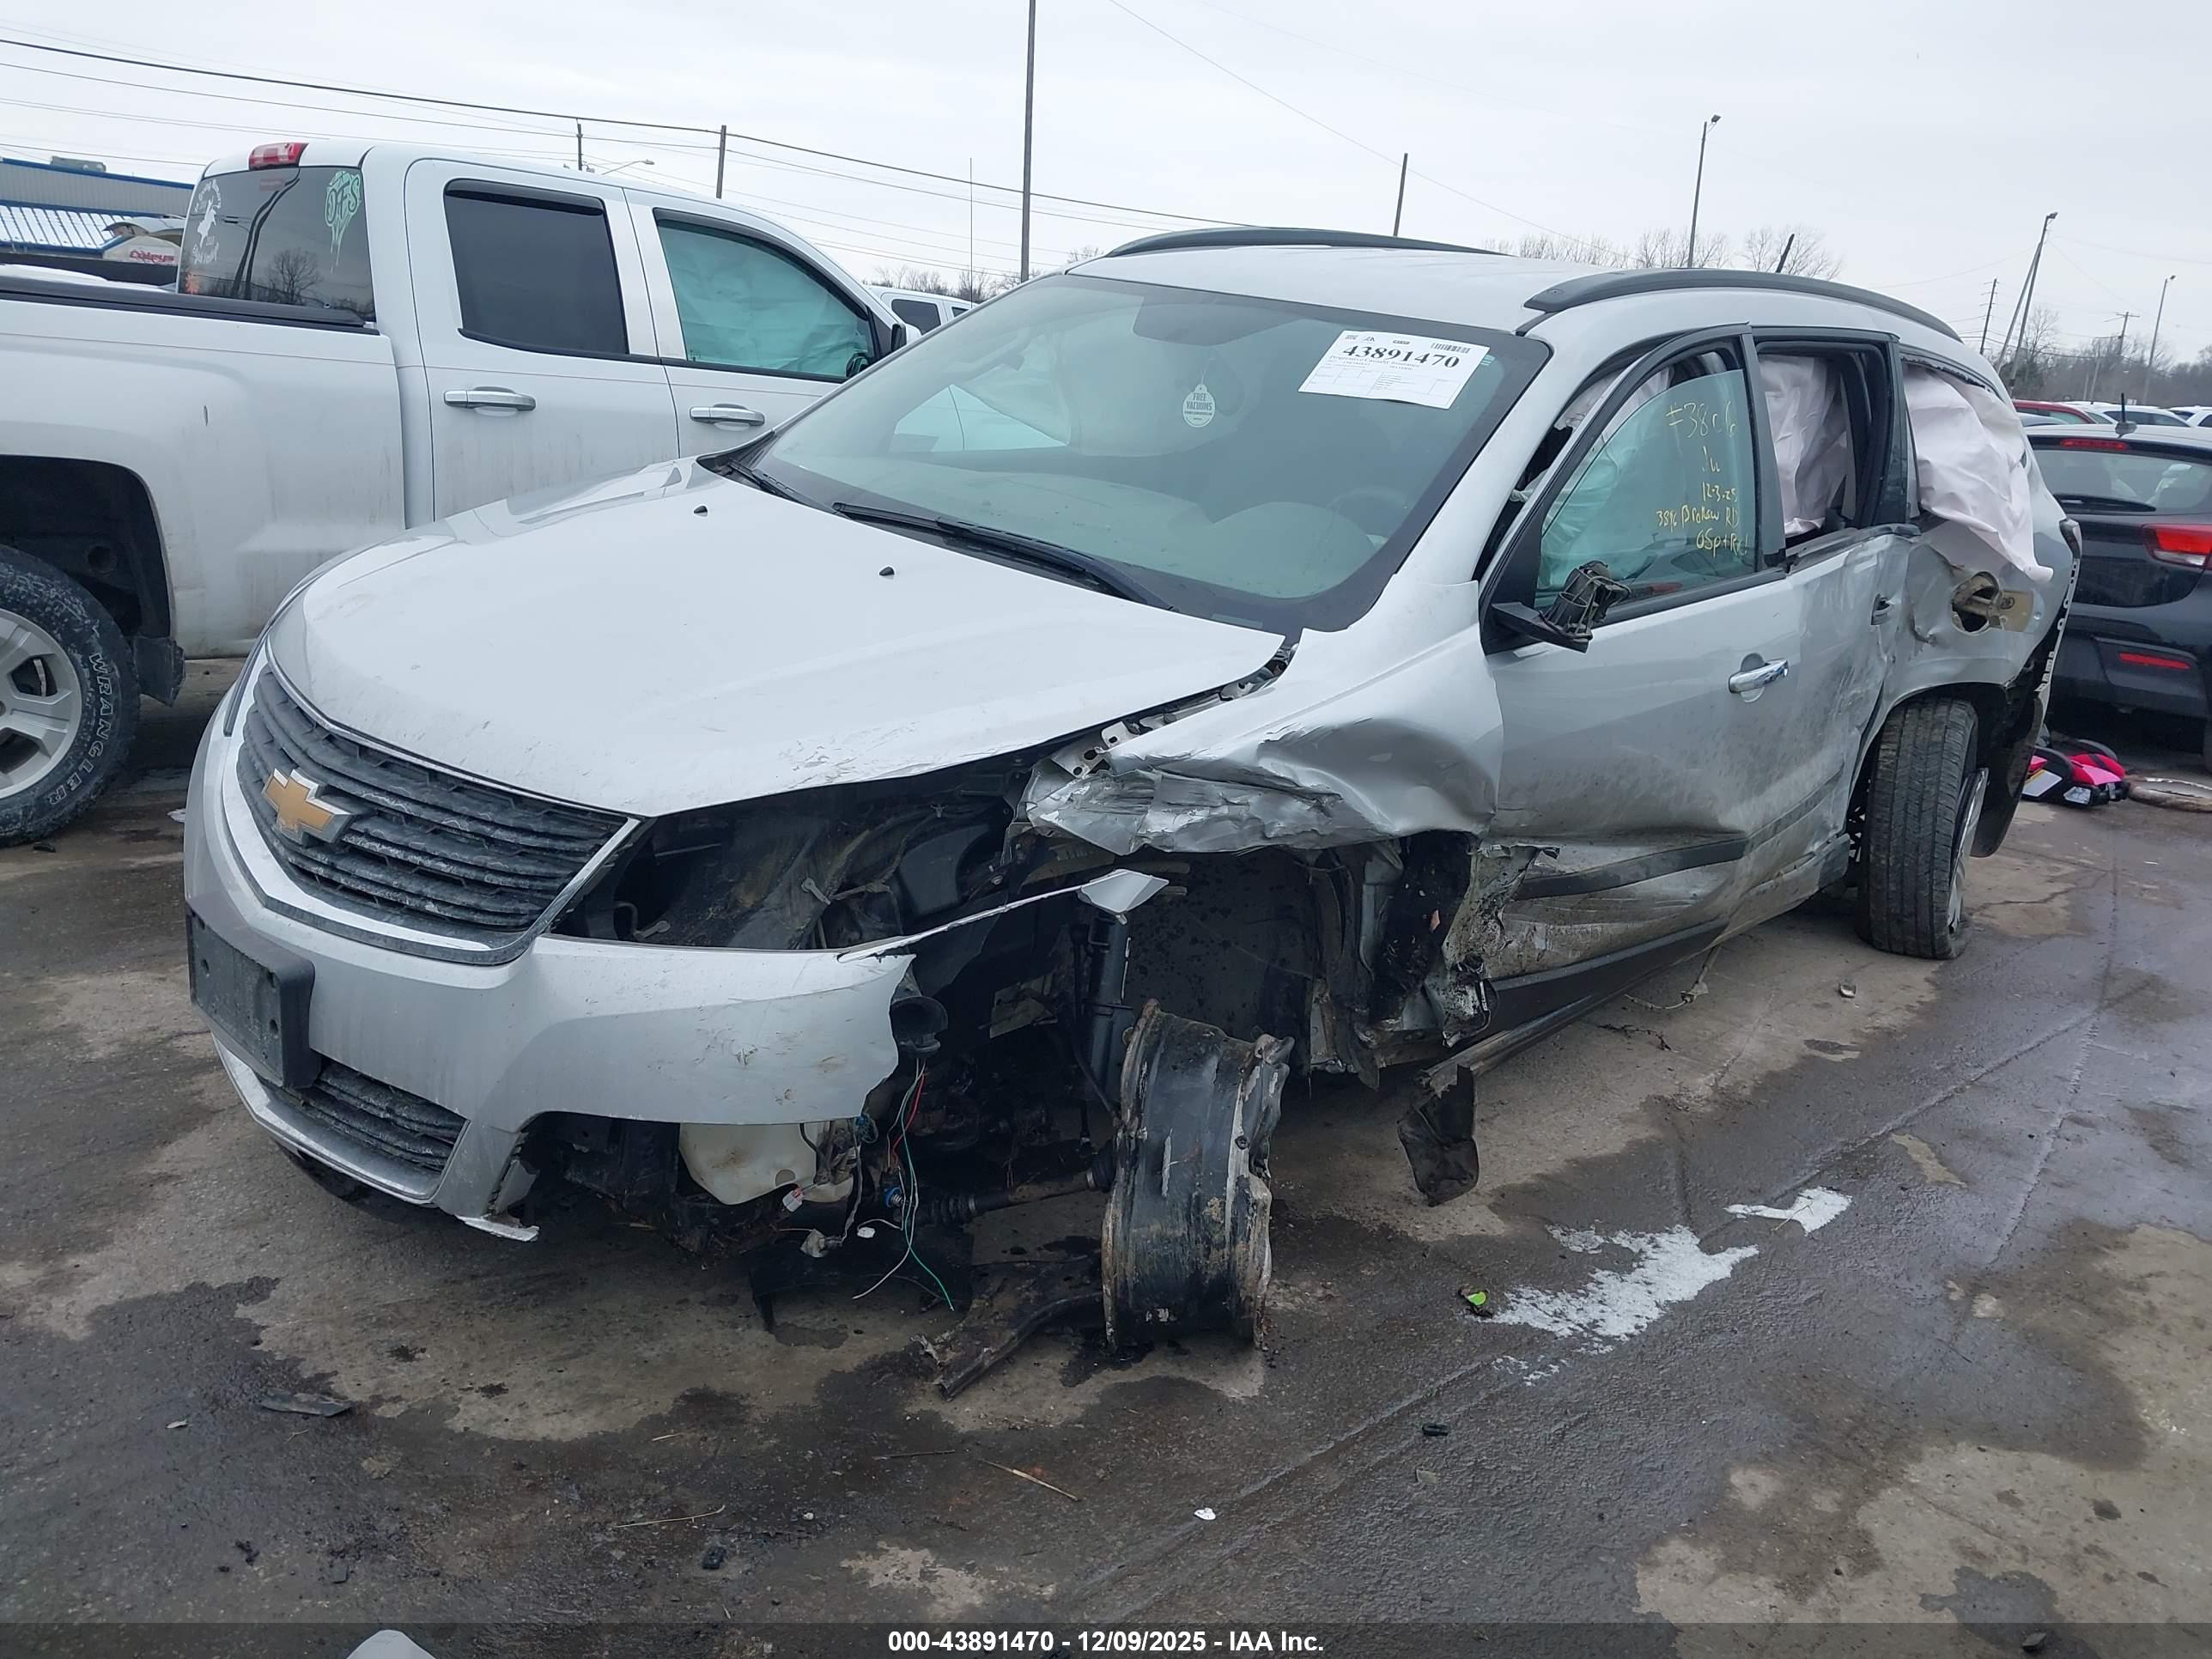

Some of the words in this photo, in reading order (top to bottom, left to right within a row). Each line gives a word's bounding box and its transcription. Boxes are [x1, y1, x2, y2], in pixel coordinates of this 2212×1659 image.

[1343, 345, 1460, 369] 43891470
[1193, 392, 1206, 401] FREE
[1186, 401, 1212, 411] VACUUMS
[49, 653, 113, 805] WRANGLER
